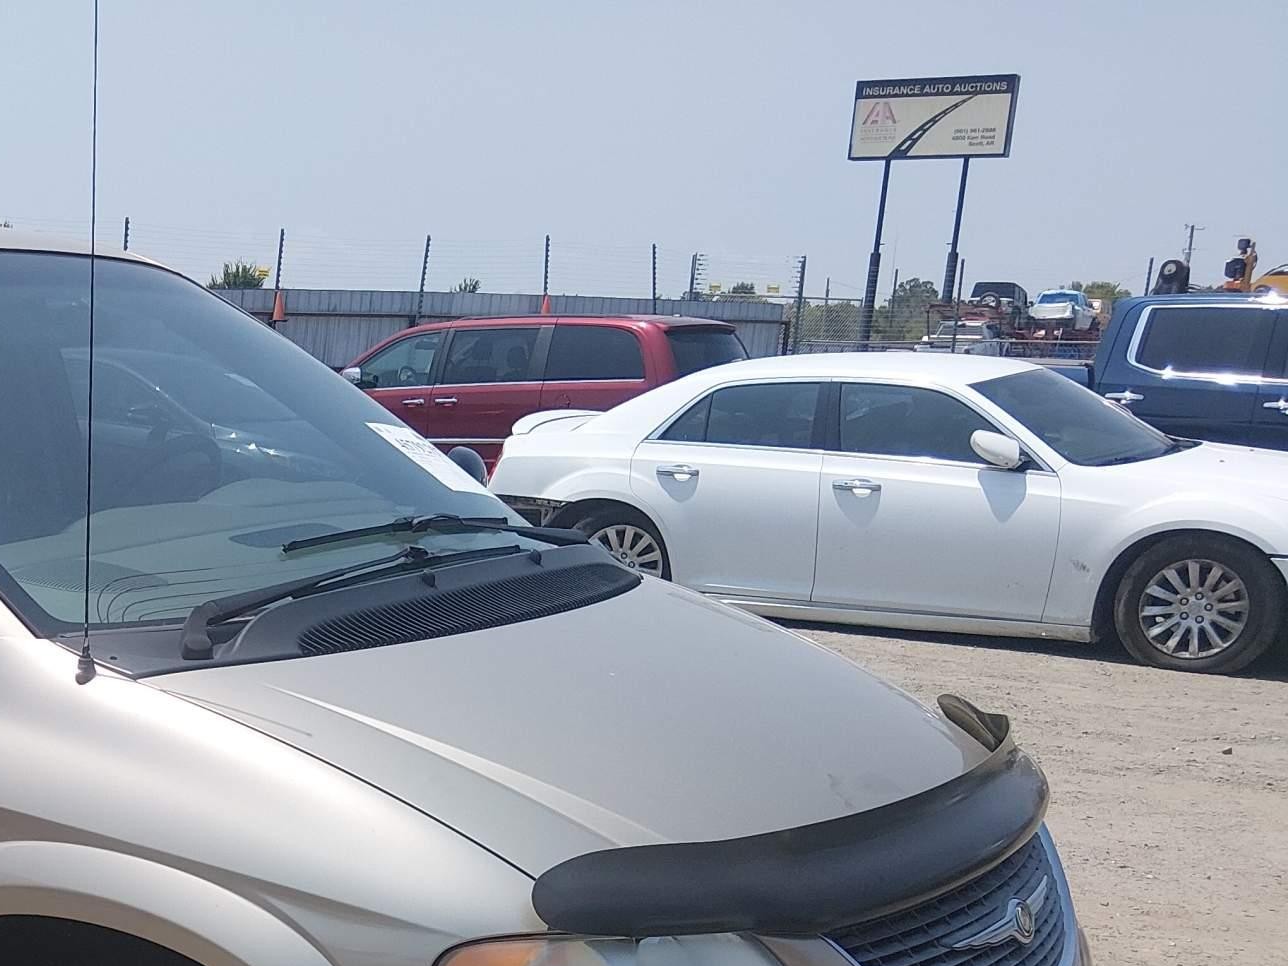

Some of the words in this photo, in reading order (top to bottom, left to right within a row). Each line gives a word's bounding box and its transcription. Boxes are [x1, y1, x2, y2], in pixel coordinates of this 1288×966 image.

[862, 85, 921, 96] INSURANCE
[923, 83, 952, 93] AUTO
[953, 81, 1008, 92] AUCTIONS
